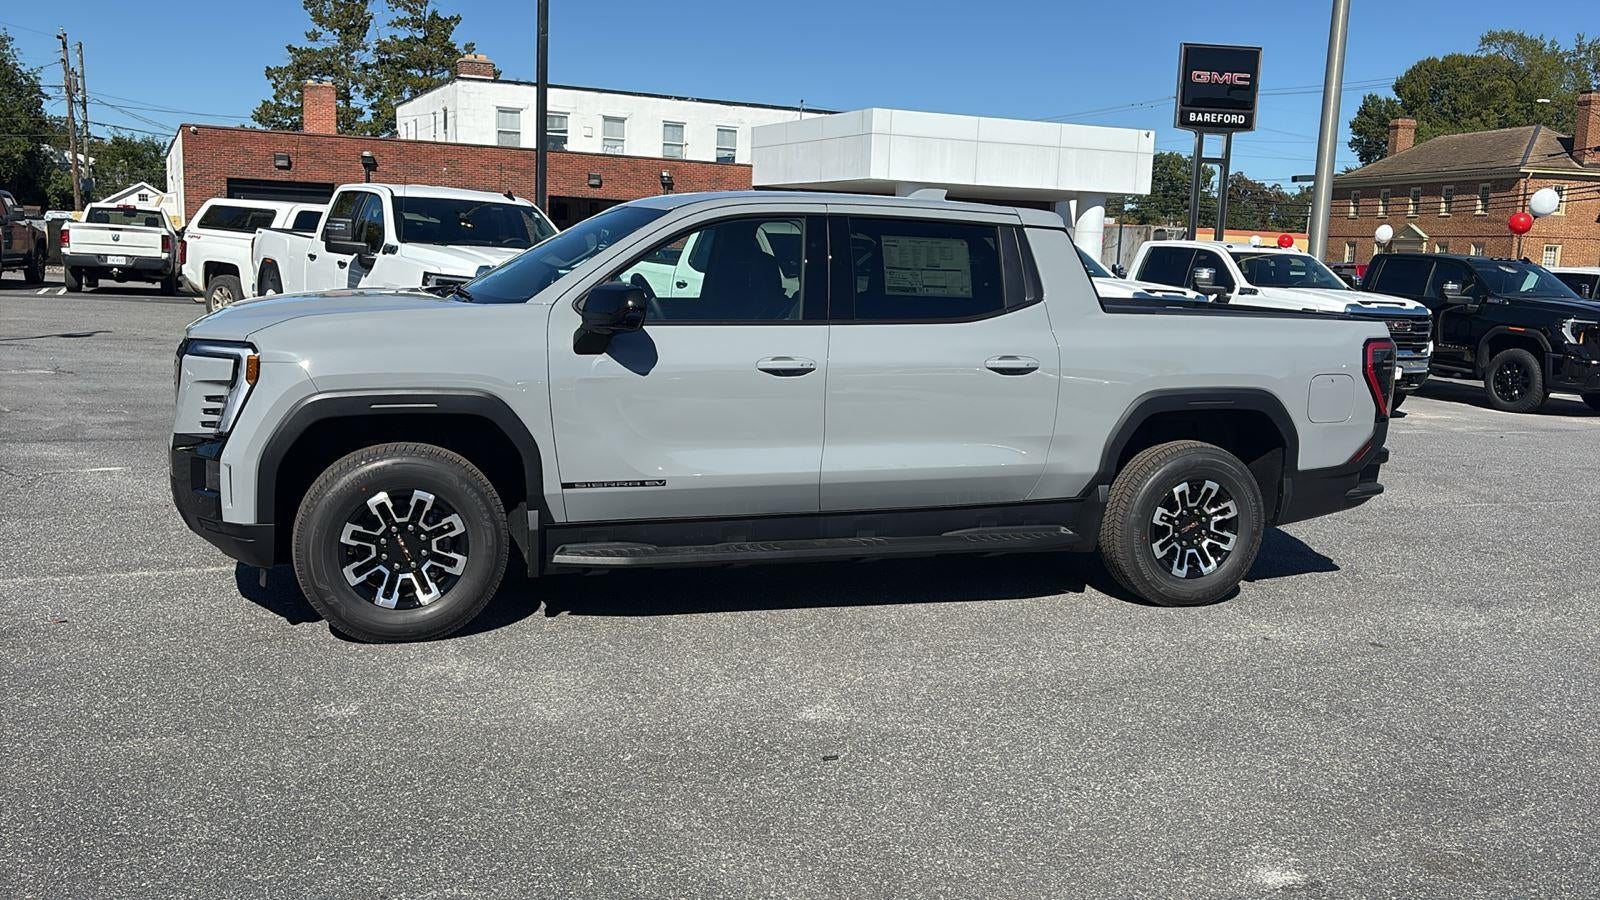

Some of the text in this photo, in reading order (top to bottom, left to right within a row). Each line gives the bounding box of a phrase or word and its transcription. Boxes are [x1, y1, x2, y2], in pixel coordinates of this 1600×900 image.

[1191, 70, 1251, 86] GMC
[1189, 112, 1246, 124] BAREFORD
[574, 479, 666, 489] SIERRA EV
